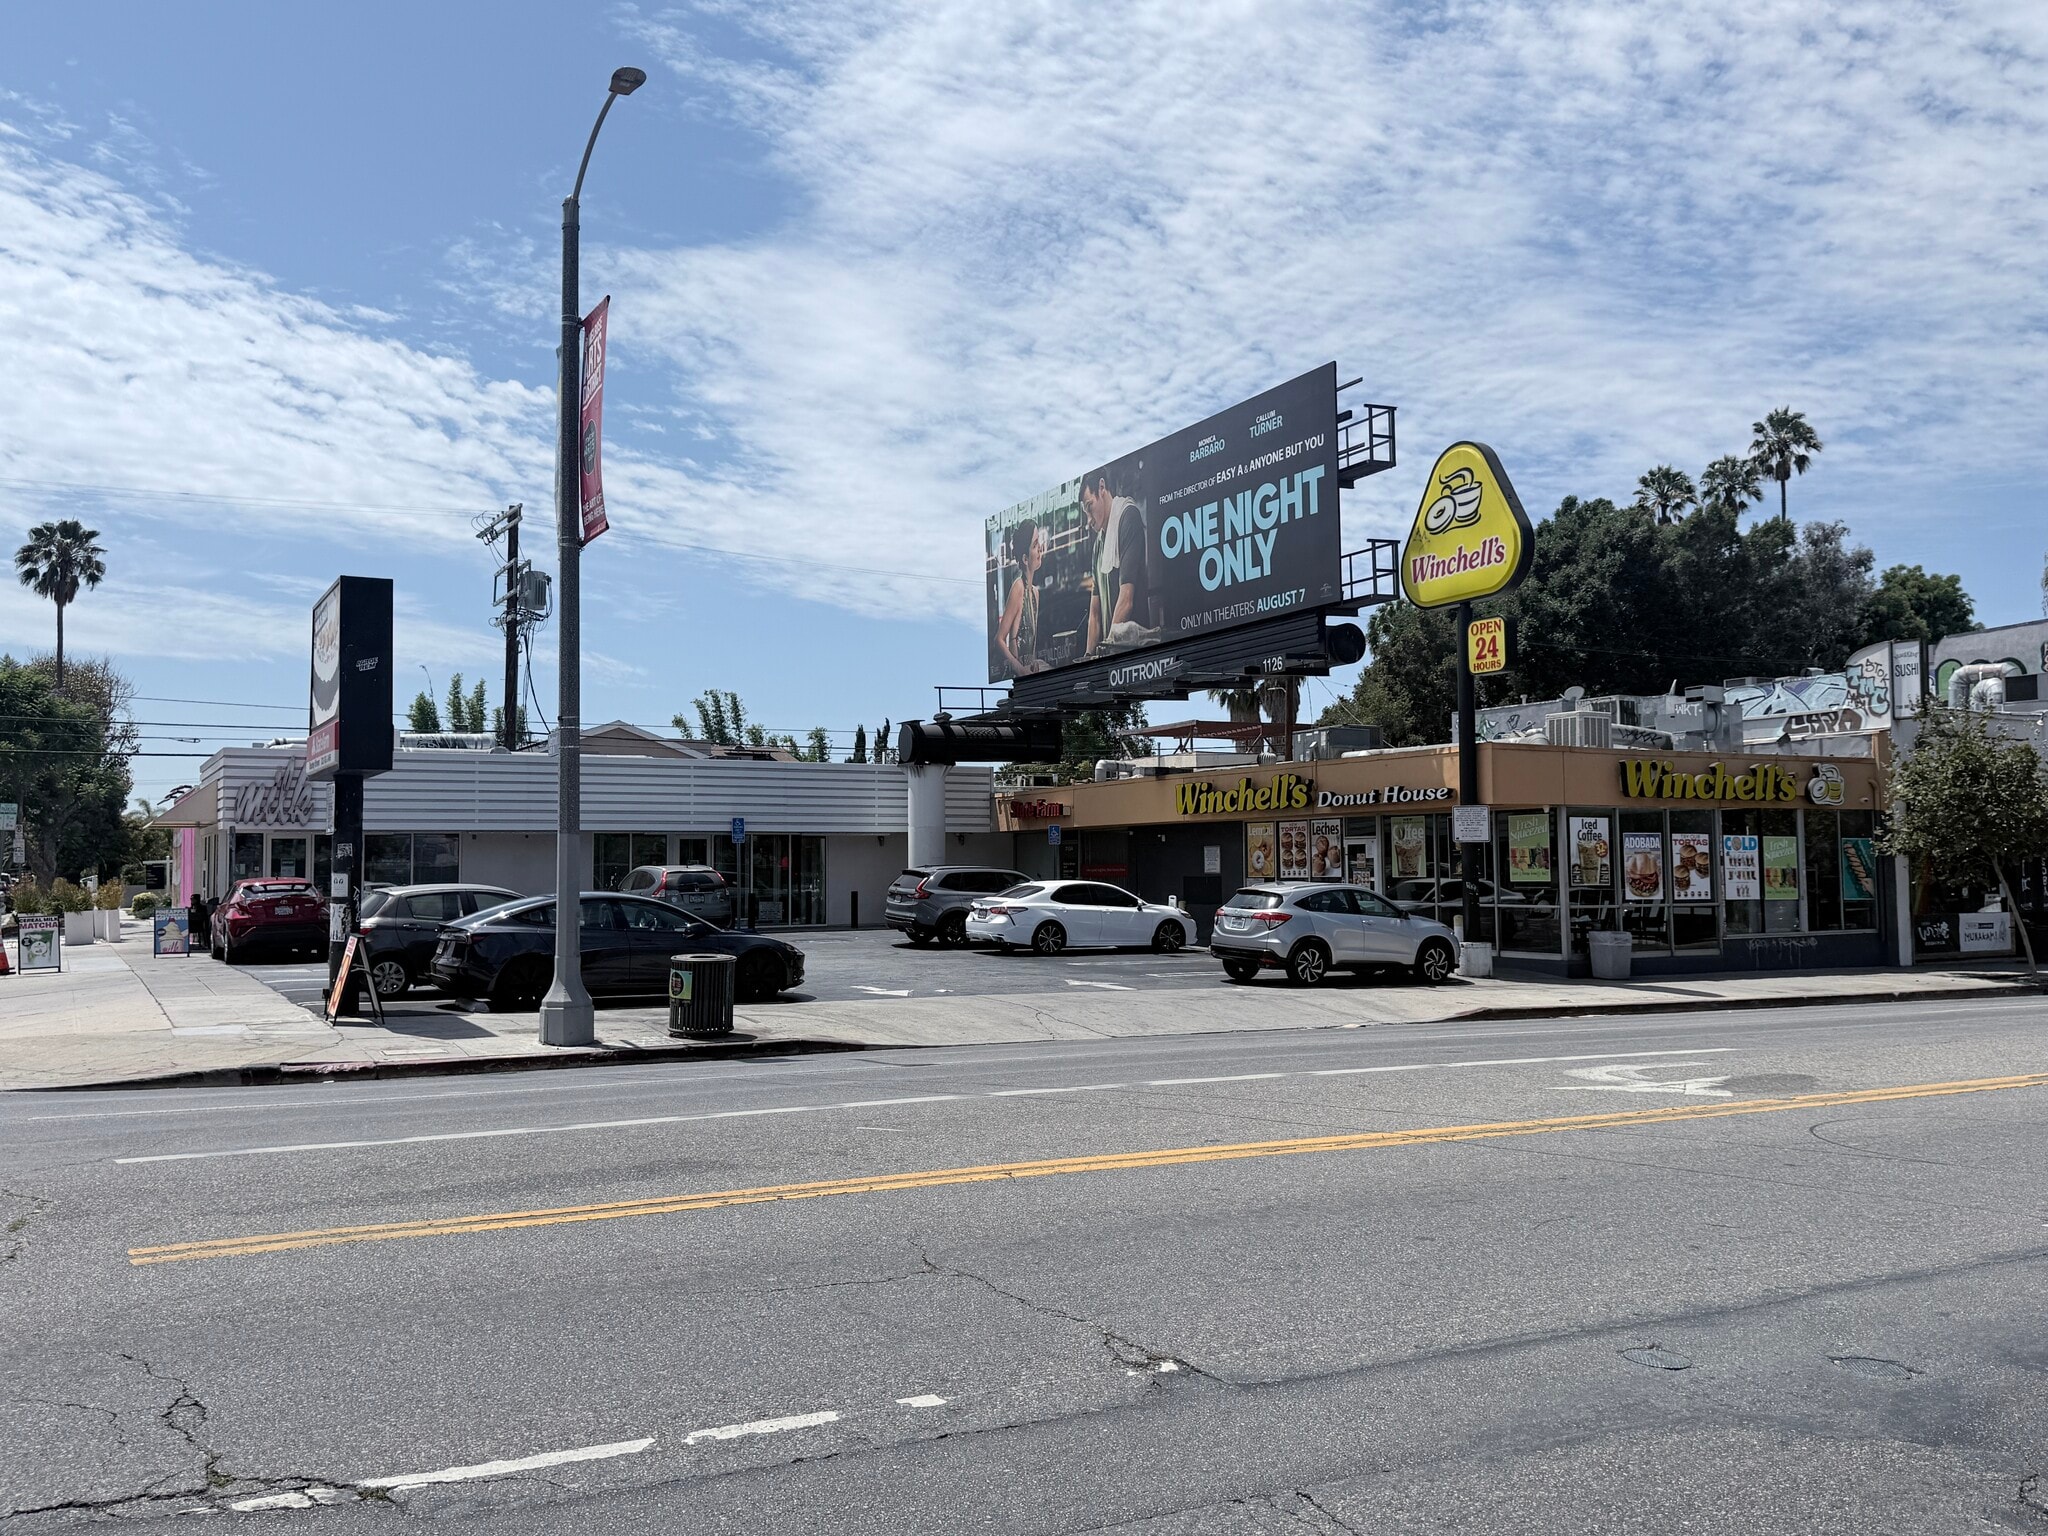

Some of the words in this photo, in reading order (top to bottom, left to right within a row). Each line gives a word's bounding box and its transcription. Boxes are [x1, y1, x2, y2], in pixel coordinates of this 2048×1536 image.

[584, 331, 602, 386] ARTS
[1255, 410, 1276, 424] CALLUM
[1249, 415, 1283, 438] TURNER
[1198, 435, 1216, 447] MONICA
[1189, 439, 1226, 463] BARBARO
[1159, 491, 1173, 505] FROM
[1173, 486, 1183, 500] THE
[1183, 479, 1208, 496] DIRECTOR
[1208, 476, 1216, 488] OF
[1216, 466, 1236, 484] EASY
[1237, 464, 1244, 476] A
[1244, 466, 1249, 474] &
[1249, 449, 1284, 472] ANYONE
[1285, 442, 1303, 458] BUT
[1304, 433, 1325, 452] YOU
[1160, 501, 1219, 559] ONE
[1224, 464, 1325, 541] NIGHT
[1199, 528, 1278, 592] ONLY
[1412, 537, 1505, 584] Winchell's
[1180, 613, 1202, 630] ONLY
[1203, 611, 1212, 624] IN
[1213, 600, 1255, 620] THEATERS
[1257, 589, 1298, 612] AUGUST
[1299, 588, 1306, 603] 7
[1470, 620, 1502, 636] OPEN
[1475, 635, 1499, 660] 24
[1262, 656, 1283, 673] 1126
[1473, 660, 1502, 671] HOURS
[1895, 663, 1919, 677] SUSHI
[1622, 759, 1797, 801] Winchell's
[1175, 773, 1309, 815] Winchell's
[1317, 791, 1375, 808] Donut
[1382, 785, 1449, 805] House
[1011, 801, 1035, 818] State
[1036, 800, 1060, 817] Farm
[1312, 822, 1339, 836] Leches
[1516, 817, 1538, 830] Fresh
[1581, 819, 1597, 830] Iced
[1393, 824, 1424, 840] Coffee
[1511, 823, 1549, 841] Squeezed
[1577, 830, 1602, 841] Coffee
[1624, 837, 1660, 848] ADOBADA
[1725, 836, 1757, 851] COLD
[1770, 839, 1788, 851] Fresh
[1964, 931, 1998, 942] MURAKAMI
